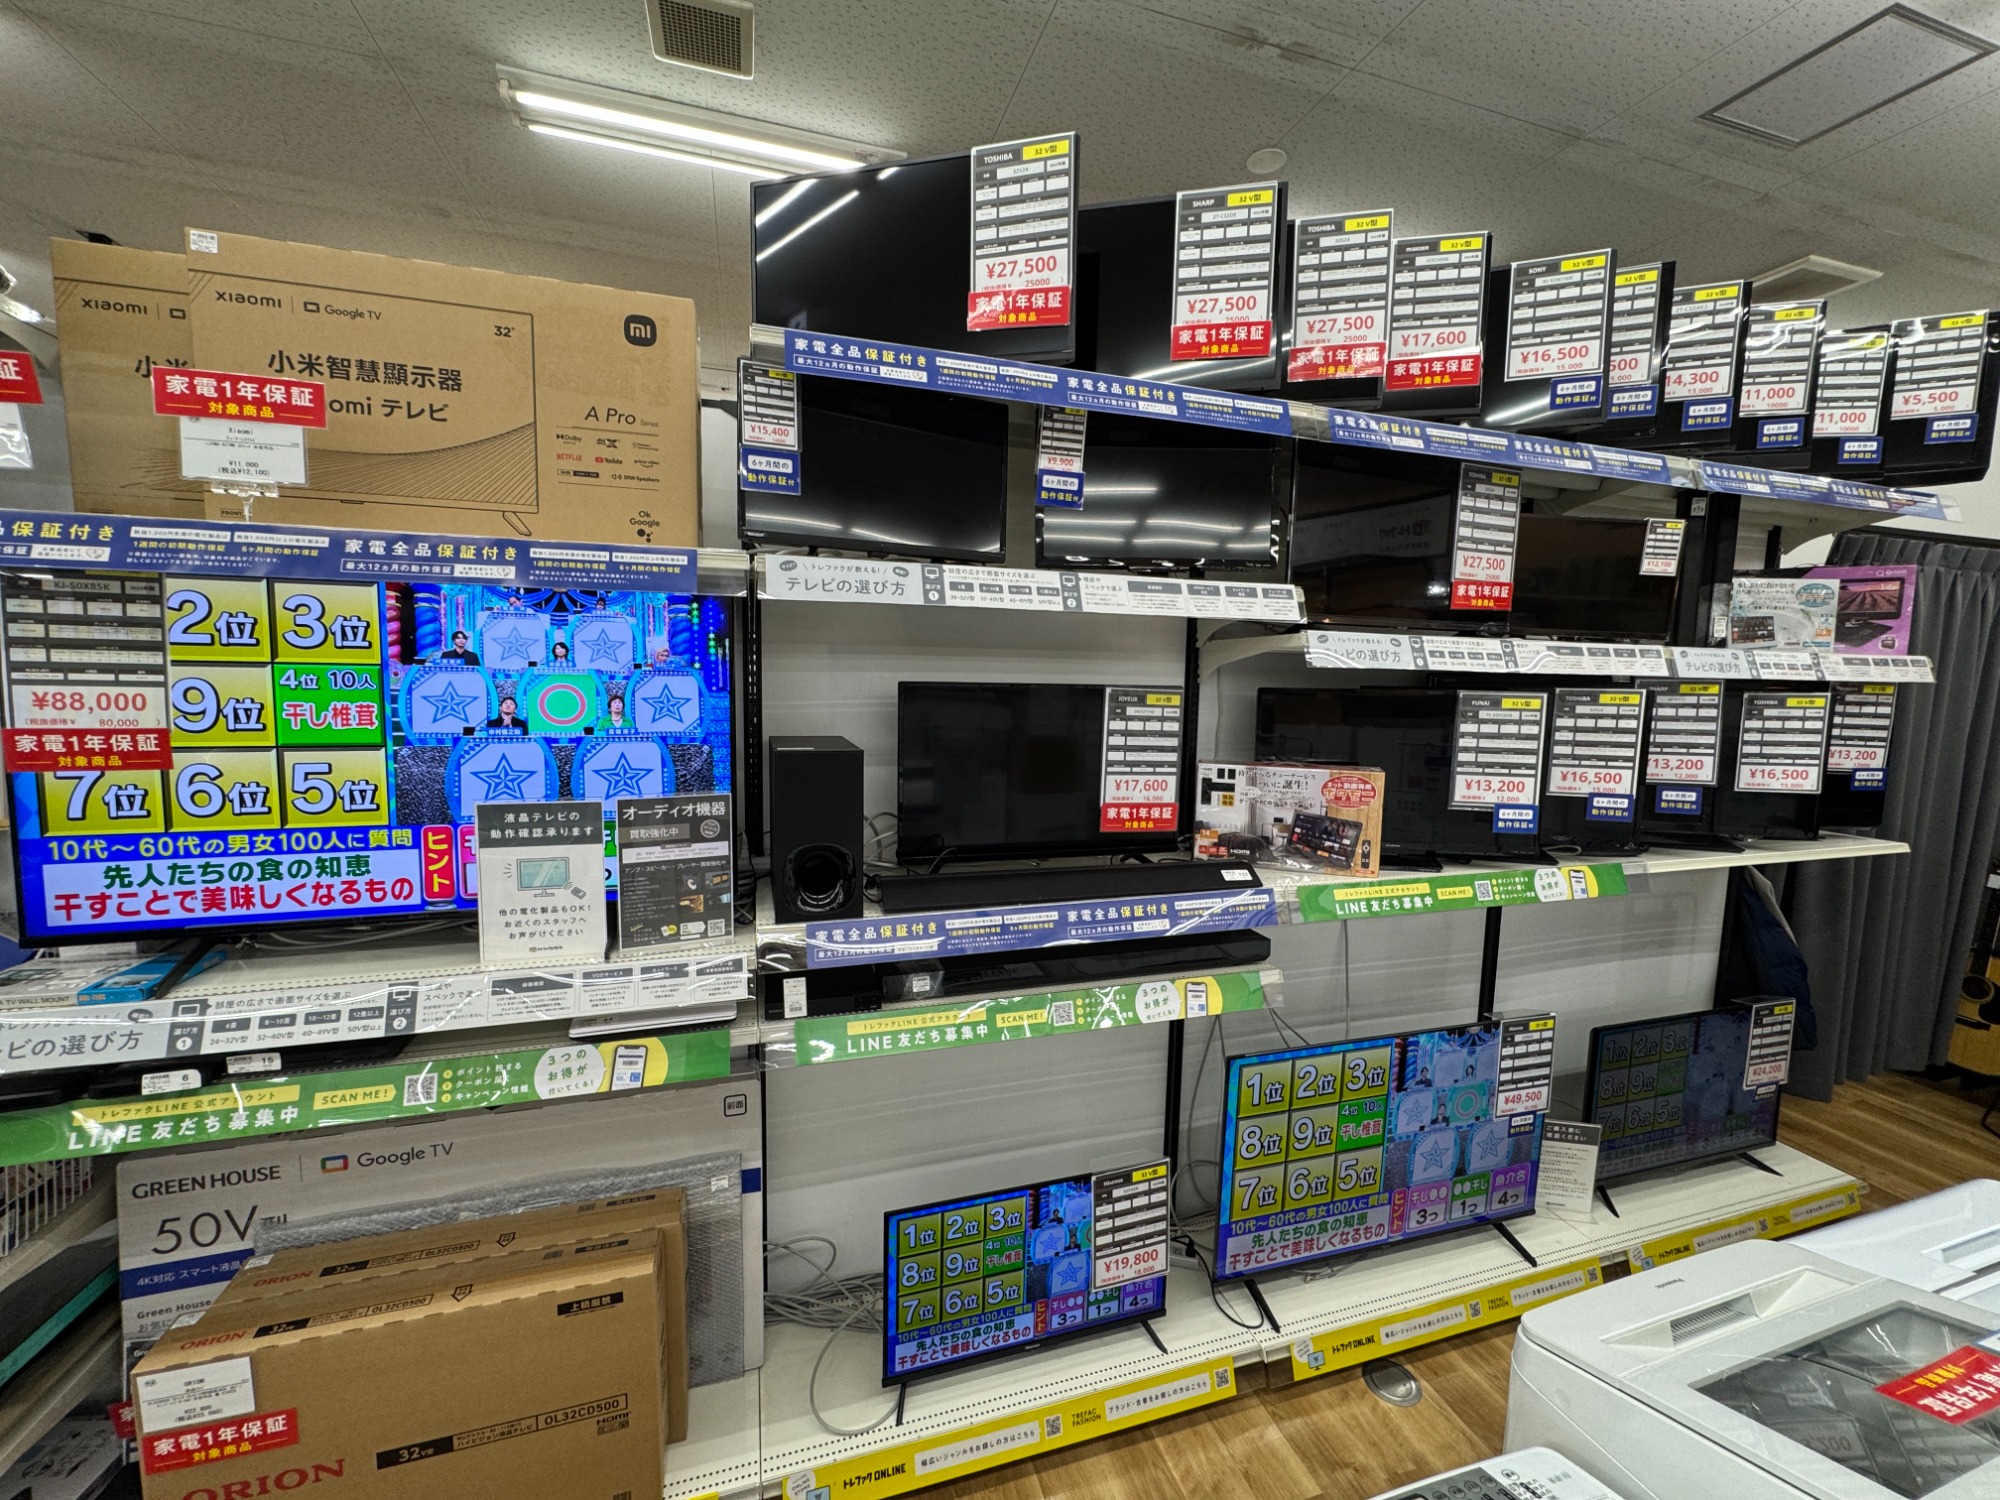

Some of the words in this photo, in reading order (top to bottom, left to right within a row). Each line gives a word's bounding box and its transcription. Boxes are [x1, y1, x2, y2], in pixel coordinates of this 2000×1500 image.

[983, 152, 1013, 164] TOSHIBA
[1192, 198, 1215, 208] SHARP
[1307, 224, 1336, 233] TOSHIBA
[985, 255, 1057, 279] ¥27,500
[1528, 266, 1547, 274] SONY
[215, 290, 282, 309] xiaomi
[1187, 295, 1257, 315] ¥27,500
[324, 304, 366, 320] Google
[366, 309, 382, 320] TV
[999, 312, 1037, 325] 対象商品
[1306, 315, 1375, 334] ¥27,500
[1178, 325, 1265, 345] 家電1年保証
[1401, 330, 1467, 348] ¥17,600
[794, 337, 928, 368] 家電全品保証付き
[1201, 343, 1239, 355] 対象商品
[1520, 345, 1589, 365] ¥16,500
[267, 349, 463, 393] 小米智慧顯示器
[1393, 358, 1474, 377] 家電1年保証
[1066, 376, 1176, 401] 家電全品保証付き
[1414, 374, 1451, 386] 対象商品
[164, 374, 315, 408] 家電1年保証
[1902, 390, 1958, 406] ¥5,500
[208, 401, 275, 419] 対象商品
[584, 405, 600, 422] A
[606, 407, 637, 425] Pro
[228, 427, 254, 436] Xiaomi
[564, 433, 583, 443] Dolby
[749, 423, 790, 438] ¥15,400
[556, 453, 583, 462] NETFLIX
[604, 457, 623, 465] YouTube
[1046, 456, 1074, 467] ¥9,900
[221, 509, 243, 517] FRONT
[638, 510, 652, 519] Ok
[629, 517, 661, 528] Google
[133, 541, 226, 553] 1週間の初期動作保証
[344, 538, 518, 561] 家電全品保証付き
[1462, 555, 1505, 571] ¥27,500
[785, 576, 906, 596] テレビの選び方
[166, 589, 259, 647] 2位
[282, 594, 372, 650] 3位
[279, 668, 319, 690] 4位
[328, 670, 376, 690] 10人
[31, 691, 147, 714] ¥88,000
[172, 676, 265, 733] 9位
[284, 700, 378, 730] 干し椎茸
[14, 733, 161, 753] 家電1年保証
[58, 756, 123, 768] 対象商品
[1828, 749, 1877, 762] ¥13,200
[1560, 770, 1623, 785] ¥16,500
[1749, 768, 1809, 781] ¥16,500
[176, 762, 271, 817] 6位
[290, 762, 378, 816] 5位
[1114, 779, 1168, 793] ¥17,600
[1464, 778, 1525, 793] ¥13,200
[54, 770, 149, 821] 7位
[503, 811, 581, 824] 液晶テレビの
[621, 801, 727, 822] オーディオ機器
[1106, 807, 1173, 820] 家電1年保証
[490, 826, 595, 839] 動作確認承ります
[629, 827, 680, 840] 買取強化中
[1124, 820, 1155, 829] 対象商品
[426, 829, 451, 895] ヒント
[102, 853, 372, 890] 先人たちの食の知恵
[53, 876, 415, 922] 干すことで美味しくなるもの
[1335, 901, 1368, 915] LINE
[1371, 896, 1433, 913] 友だち募集中
[498, 904, 592, 917] 他の電化製品もOK!
[503, 916, 587, 928] お近くのスタッフへ
[508, 928, 584, 940] お声がけください
[1141, 984, 1169, 997] 3つの
[1144, 997, 1170, 1010] お得が
[173, 1026, 199, 1036] 選び方
[847, 1034, 893, 1053] LINE
[898, 1023, 988, 1048] 友だち募集中
[261, 1056, 274, 1065] 15
[547, 1048, 587, 1066] 3つの
[548, 1063, 588, 1081] お得が
[1346, 1057, 1384, 1091] 3位
[1752, 1063, 1783, 1077] ¥24,200
[1245, 1073, 1284, 1107] 1位
[1297, 1064, 1336, 1099] 2位
[321, 1092, 350, 1106] SCAN
[727, 1100, 744, 1111] 前面
[1503, 1090, 1542, 1106] ¥49,500
[1340, 1104, 1358, 1118] 4位
[1362, 1100, 1384, 1113] 10人
[68, 1124, 142, 1151] LINE
[152, 1106, 299, 1141] 友だち募集中
[1292, 1116, 1333, 1150] 9位
[1239, 1126, 1282, 1160] 8位
[356, 1147, 427, 1169] Google
[430, 1142, 454, 1159] TV
[131, 1175, 206, 1200] GREEN
[209, 1165, 282, 1188] HOUSE
[1103, 1176, 1124, 1187] Hisense
[1288, 1168, 1329, 1199] 6位
[1338, 1159, 1377, 1191] 5位
[1238, 1176, 1276, 1210] 7位
[1497, 1190, 1519, 1206] 4つ
[1392, 1193, 1404, 1230] ヒント
[1415, 1208, 1439, 1225] 3つ
[1459, 1199, 1478, 1216] 1つ
[946, 1214, 980, 1240] 2位
[988, 1206, 1022, 1231] 3位
[903, 1223, 936, 1248] 1位
[1251, 1211, 1369, 1249] 先人たちの食の知恵
[1229, 1223, 1386, 1269] 干すことで美味しくなるもの
[945, 1253, 980, 1277] 9位
[1103, 1248, 1160, 1274] ¥19,800
[136, 1269, 176, 1287] 4K対応
[253, 1270, 314, 1288] ORION
[901, 1262, 936, 1287] 8位
[986, 1280, 1020, 1305] 5位
[1129, 1295, 1149, 1308] 4つ
[136, 1305, 174, 1320] Green
[176, 1299, 213, 1314] House
[371, 1296, 427, 1314] OL32CD500
[944, 1290, 979, 1315] 6位
[1095, 1304, 1111, 1316] 1つ
[1488, 1301, 1510, 1311] FASHION
[901, 1300, 935, 1326] 7位
[1057, 1313, 1078, 1326] 3つ
[180, 1329, 246, 1352] ORION
[915, 1319, 1016, 1352] 先人たちの食の知恵
[897, 1326, 1031, 1369] 干すことで美味しくなるもの
[184, 1378, 206, 1387] ORION
[544, 1399, 620, 1427] OL32CD500
[1072, 1407, 1098, 1419] TREFAC
[1072, 1413, 1102, 1428] FASHION
[153, 1414, 288, 1457] 家電1年保証
